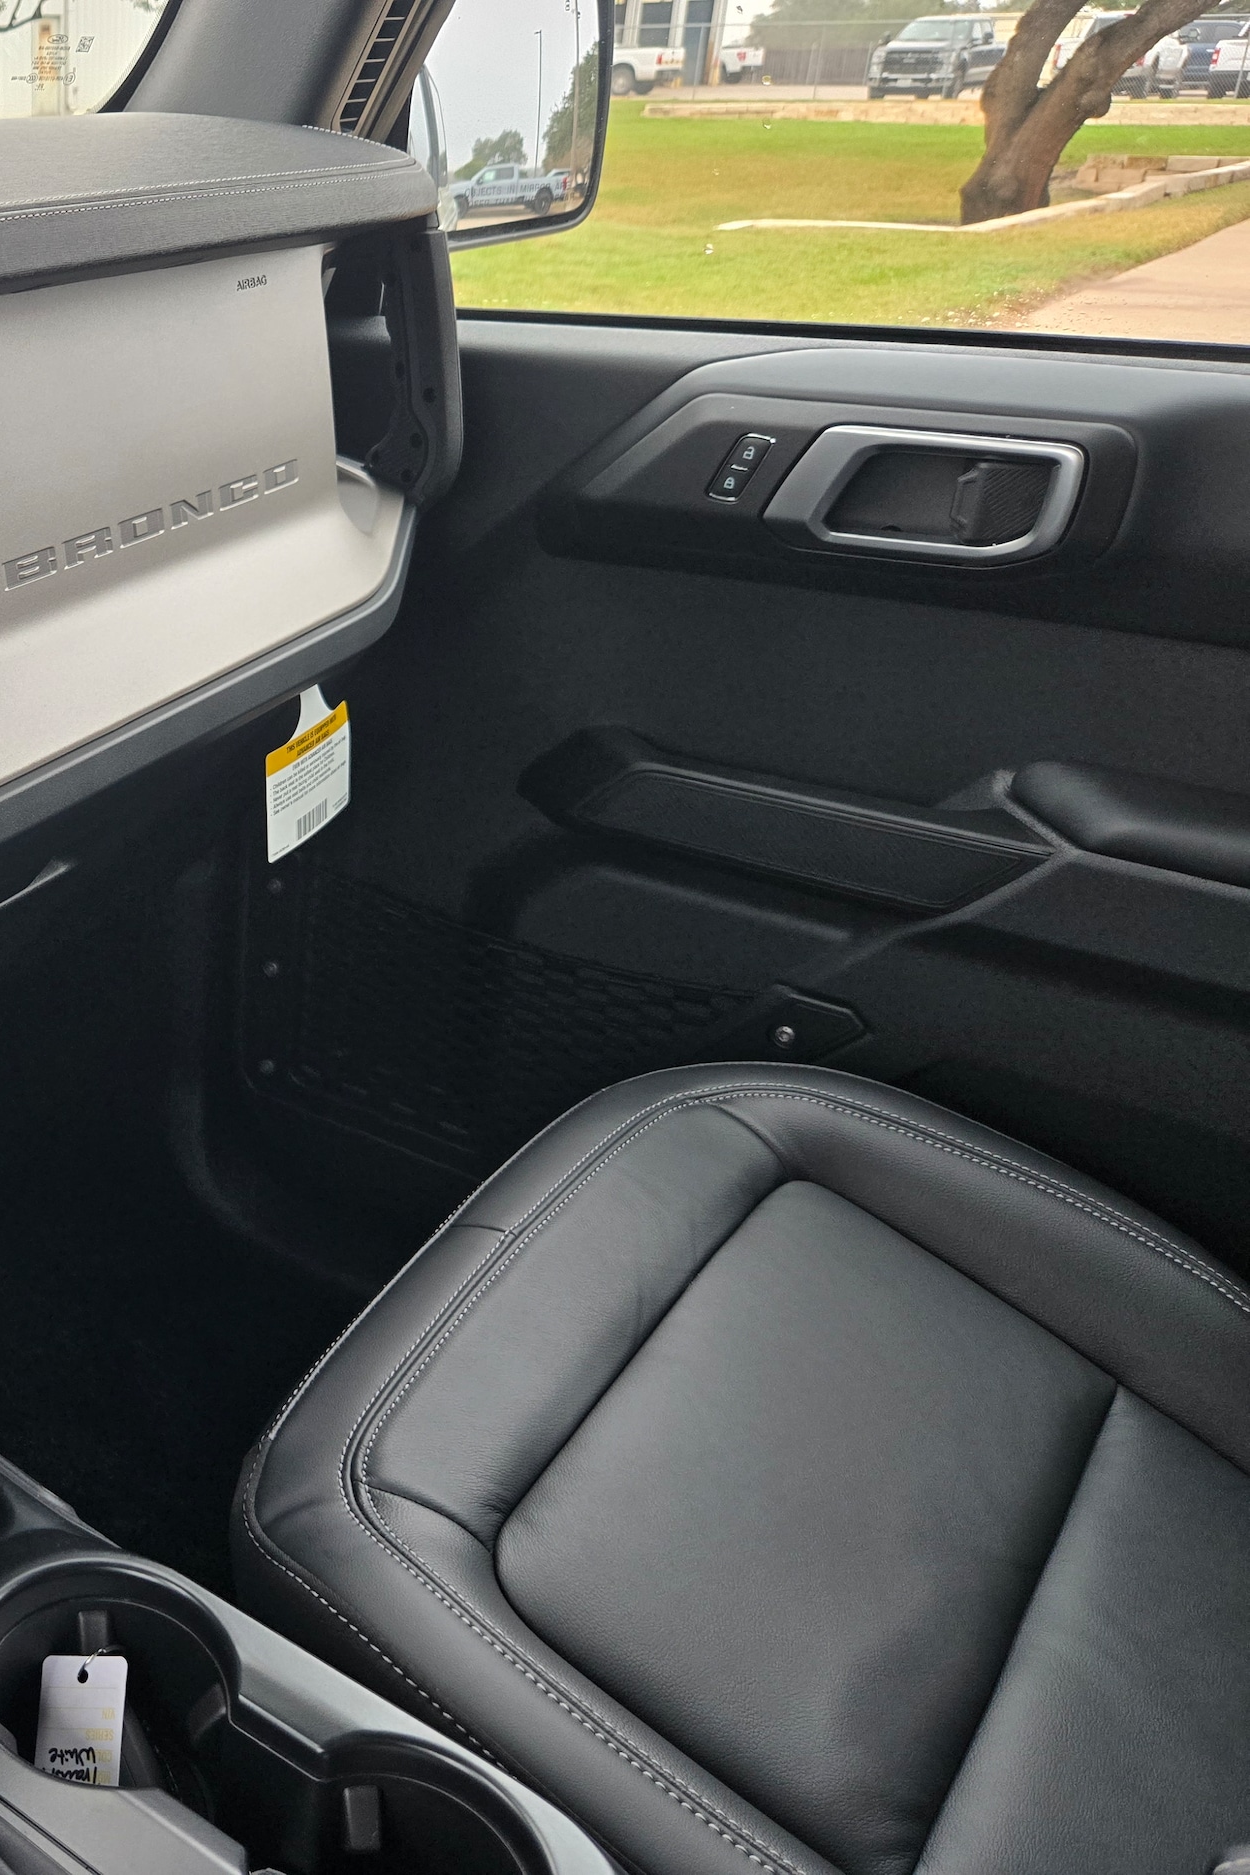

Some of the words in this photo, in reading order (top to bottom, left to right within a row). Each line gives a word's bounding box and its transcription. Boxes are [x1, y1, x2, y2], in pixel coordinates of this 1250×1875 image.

[236, 274, 267, 292] AIRBAG
[2, 458, 299, 591] BRONCO
[85, 1729, 114, 1741] SERIES
[48, 1746, 97, 1766] White
